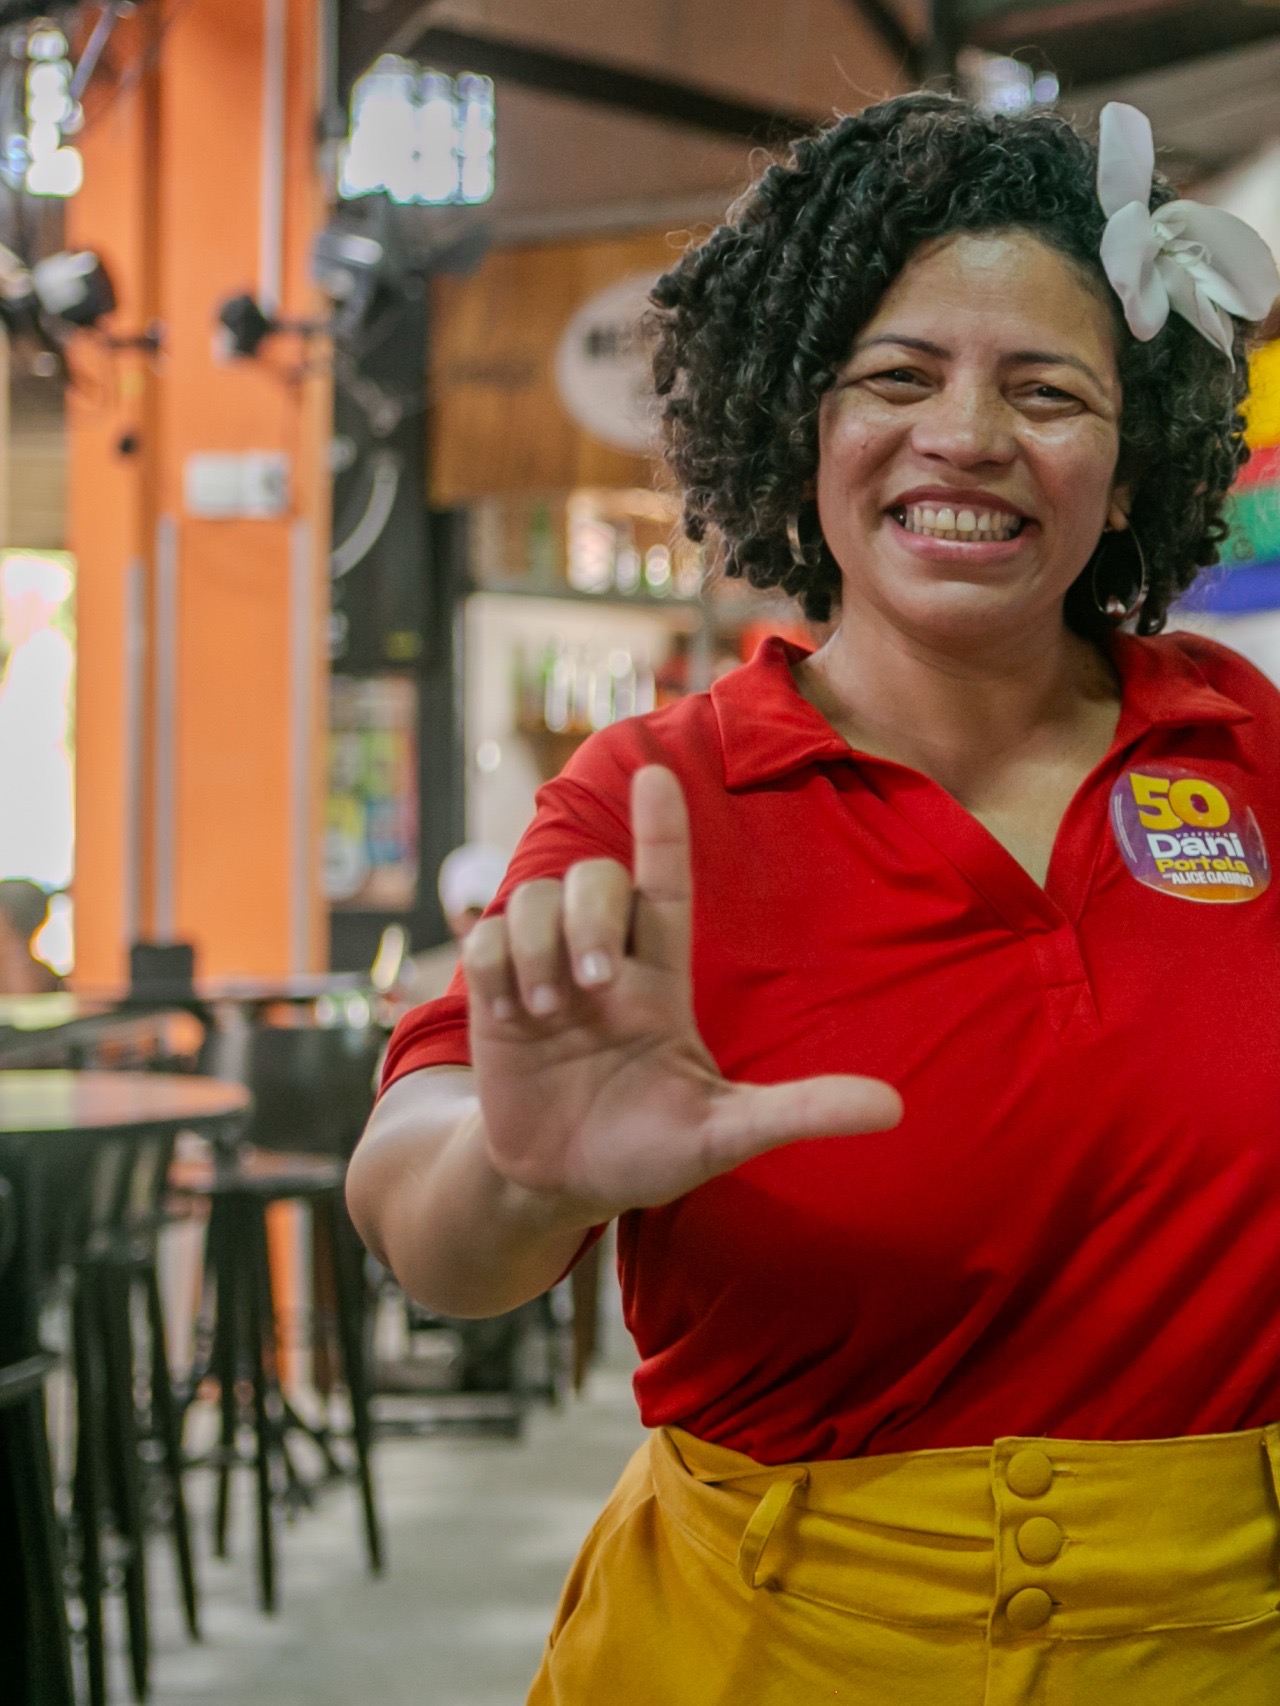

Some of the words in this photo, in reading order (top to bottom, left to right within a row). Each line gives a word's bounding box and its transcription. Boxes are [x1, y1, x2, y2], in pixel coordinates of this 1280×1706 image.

[1130, 773, 1230, 830] 50
[1146, 832, 1245, 858] Dani
[1156, 856, 1250, 873] Portela
[1172, 872, 1207, 885] ALICE
